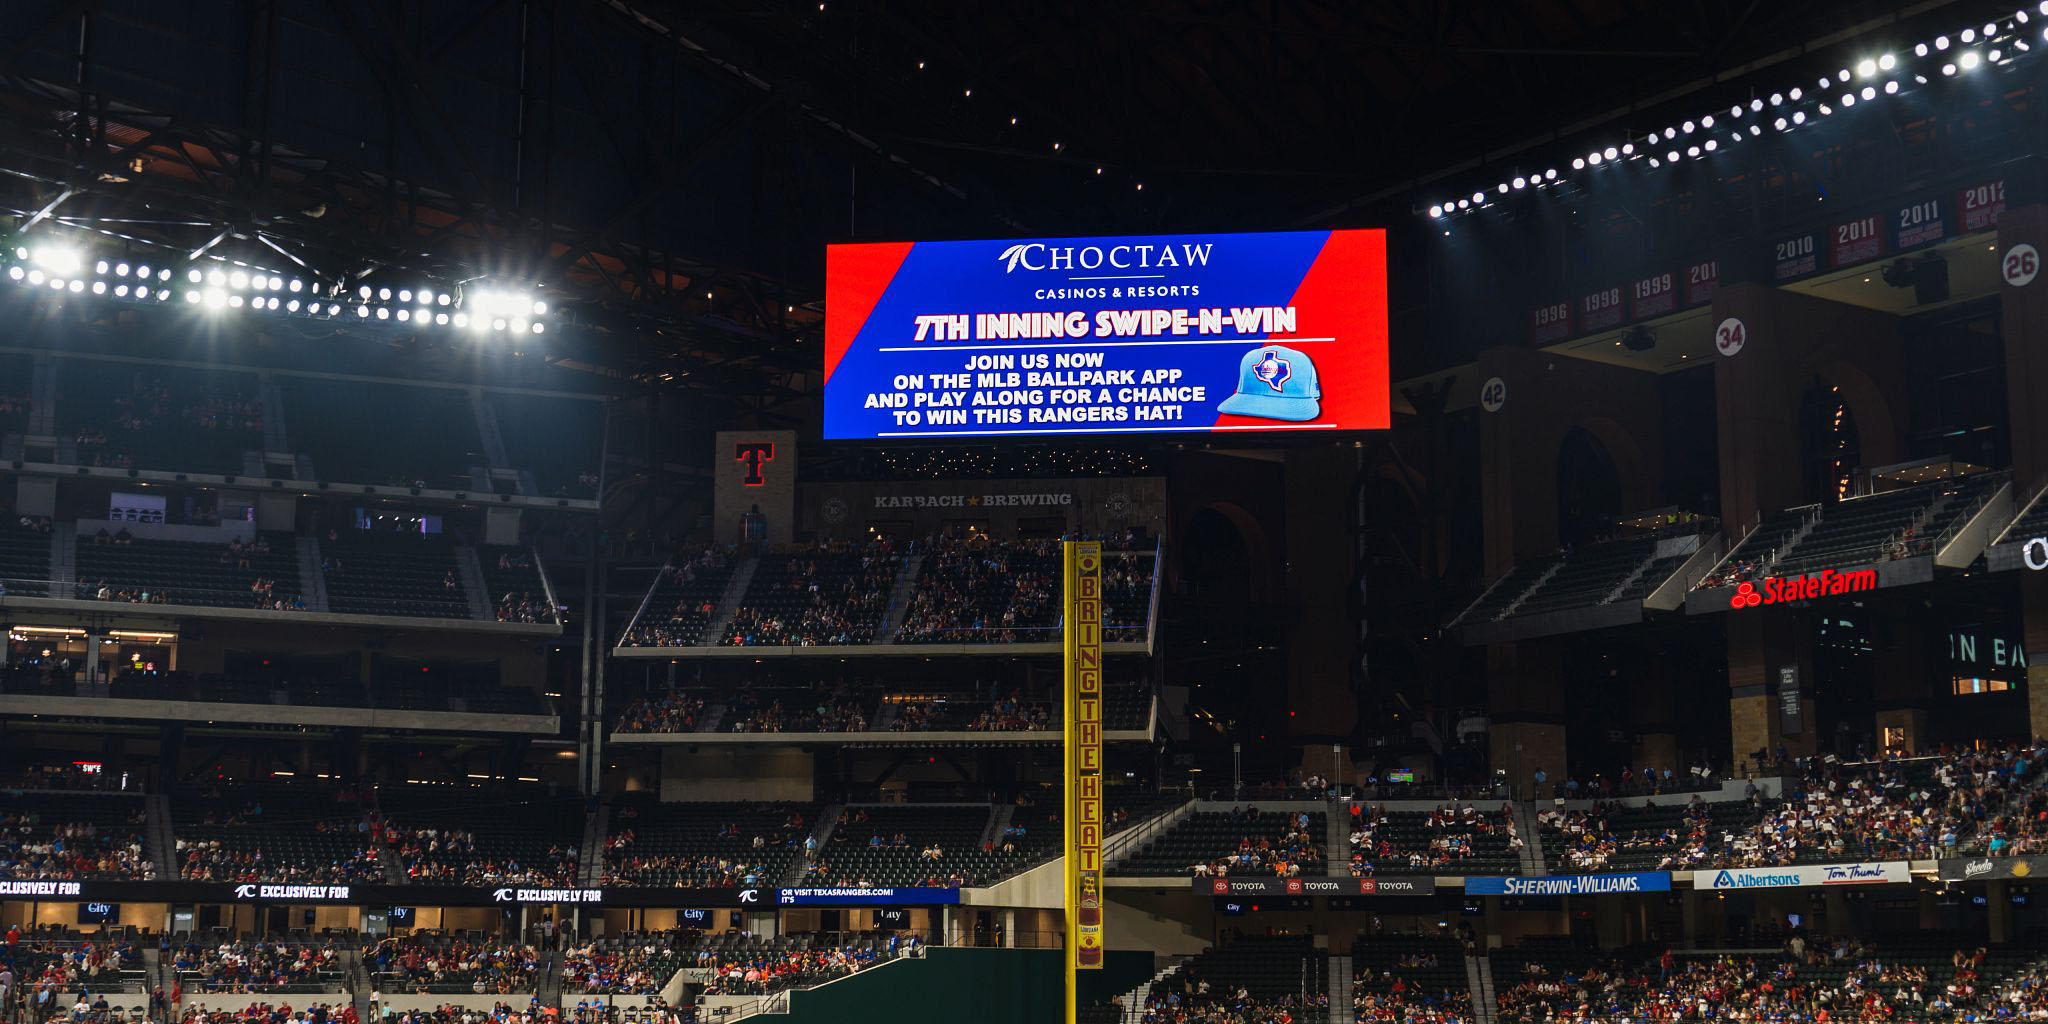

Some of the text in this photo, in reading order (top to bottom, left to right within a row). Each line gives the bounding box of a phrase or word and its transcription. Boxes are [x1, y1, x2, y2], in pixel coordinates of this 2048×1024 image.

[1900, 200, 1939, 228] 2011
[1838, 217, 1875, 244] 2011
[1019, 243, 1214, 271] CHOCTAW
[1776, 235, 1813, 261] 2010
[1690, 260, 1719, 284] 201
[2006, 251, 2036, 280] 26
[1035, 285, 1200, 300] CASINOS & RESORTS
[1634, 273, 1671, 299] 1999
[1585, 287, 1620, 312] 1998
[914, 306, 1297, 341] 7TH INNING SWIPE-N-WIN
[1535, 303, 1568, 326] 1996
[1719, 323, 1743, 349] 34
[964, 352, 1105, 371] JOIN US NOW
[893, 368, 1183, 390] ON THE MLB BALLPARK APP
[864, 386, 1206, 409] AND PLAY ALONG FOR A CHANCE
[1483, 384, 1503, 406] 42
[892, 404, 1183, 426] TO WIN THIS RANGERS HAT!
[736, 443, 775, 486] T
[874, 493, 1072, 509] KARBACH BREWING
[1081, 578, 1096, 869] BRING THE HEAT
[1737, 872, 1801, 888] Albertsons
[1823, 864, 1885, 881] Tom Thumb
[58, 882, 81, 895] FOR
[260, 885, 327, 898] EXCLUSIVELY
[329, 886, 349, 899] FOR
[583, 890, 602, 902] FOR
[813, 889, 894, 897] TEXASRANGERS.COM!
[1231, 882, 1266, 891] TOYOTA
[1304, 882, 1339, 891] TOYOTA
[1378, 882, 1413, 891] TOYOTA
[88, 902, 111, 915] City
[781, 896, 795, 904] IT'S
